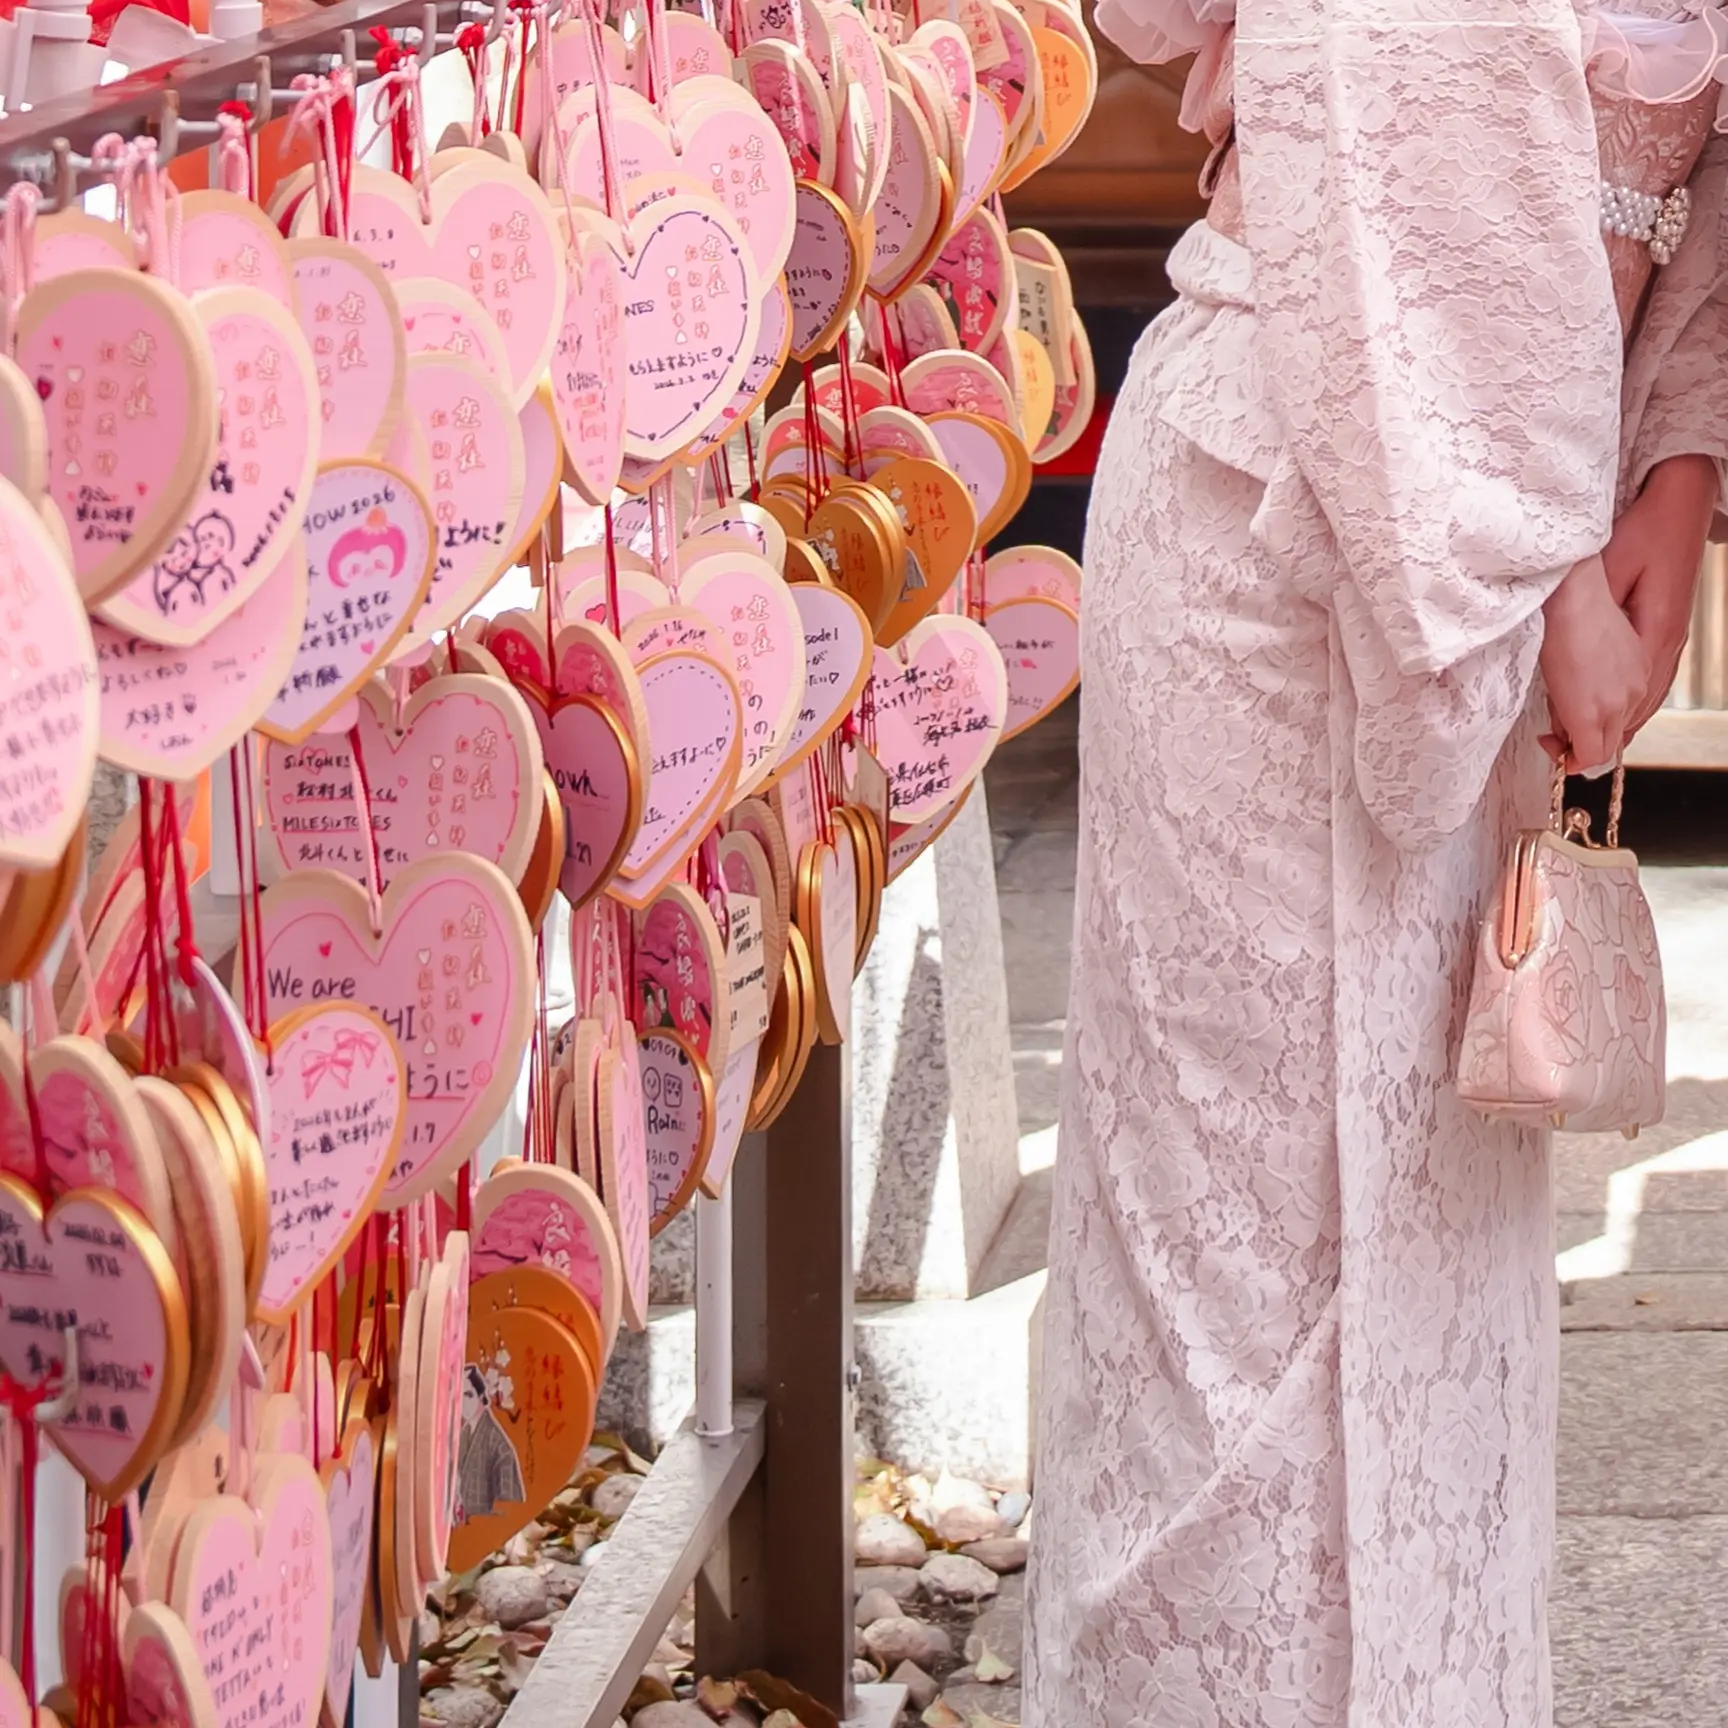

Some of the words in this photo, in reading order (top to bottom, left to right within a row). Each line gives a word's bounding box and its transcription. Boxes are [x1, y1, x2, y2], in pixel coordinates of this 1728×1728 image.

[296, 781, 399, 802] 松村北くん
[268, 967, 304, 1000] We
[311, 976, 357, 1000] are
